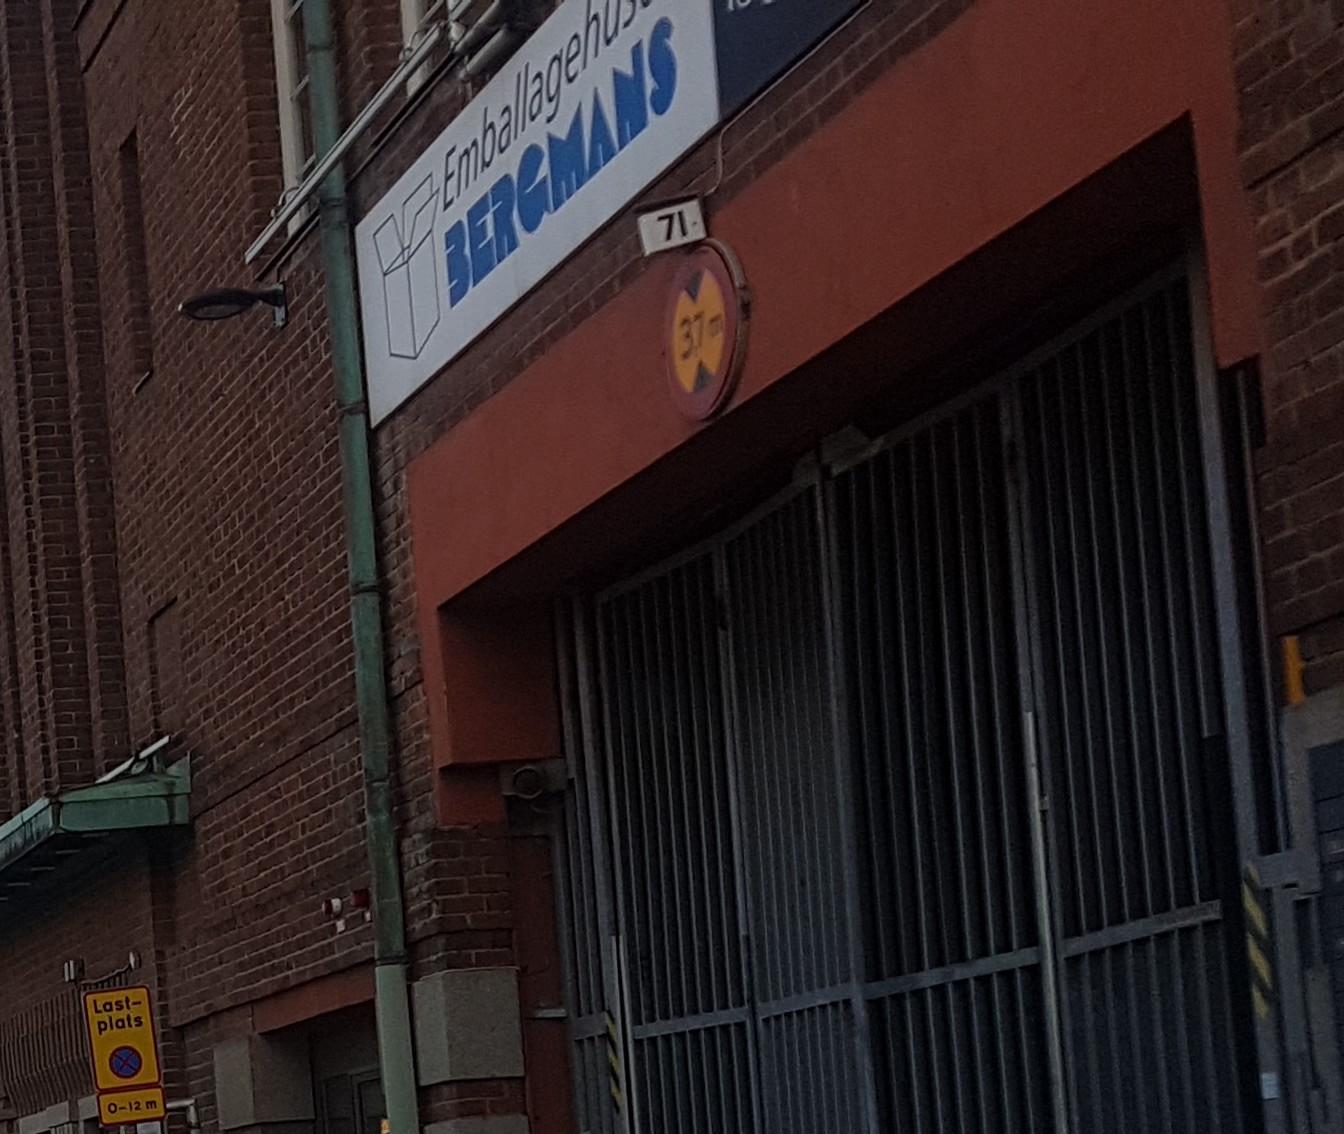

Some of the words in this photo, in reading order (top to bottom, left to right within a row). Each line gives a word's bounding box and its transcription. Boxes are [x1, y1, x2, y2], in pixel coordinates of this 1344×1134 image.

[444, 16, 678, 309] BERGMANS
[657, 211, 688, 241] 71
[93, 996, 142, 1014] Last-
[97, 1015, 144, 1035] plats
[107, 1101, 142, 1114] 0-12
[145, 1100, 158, 1110] m
